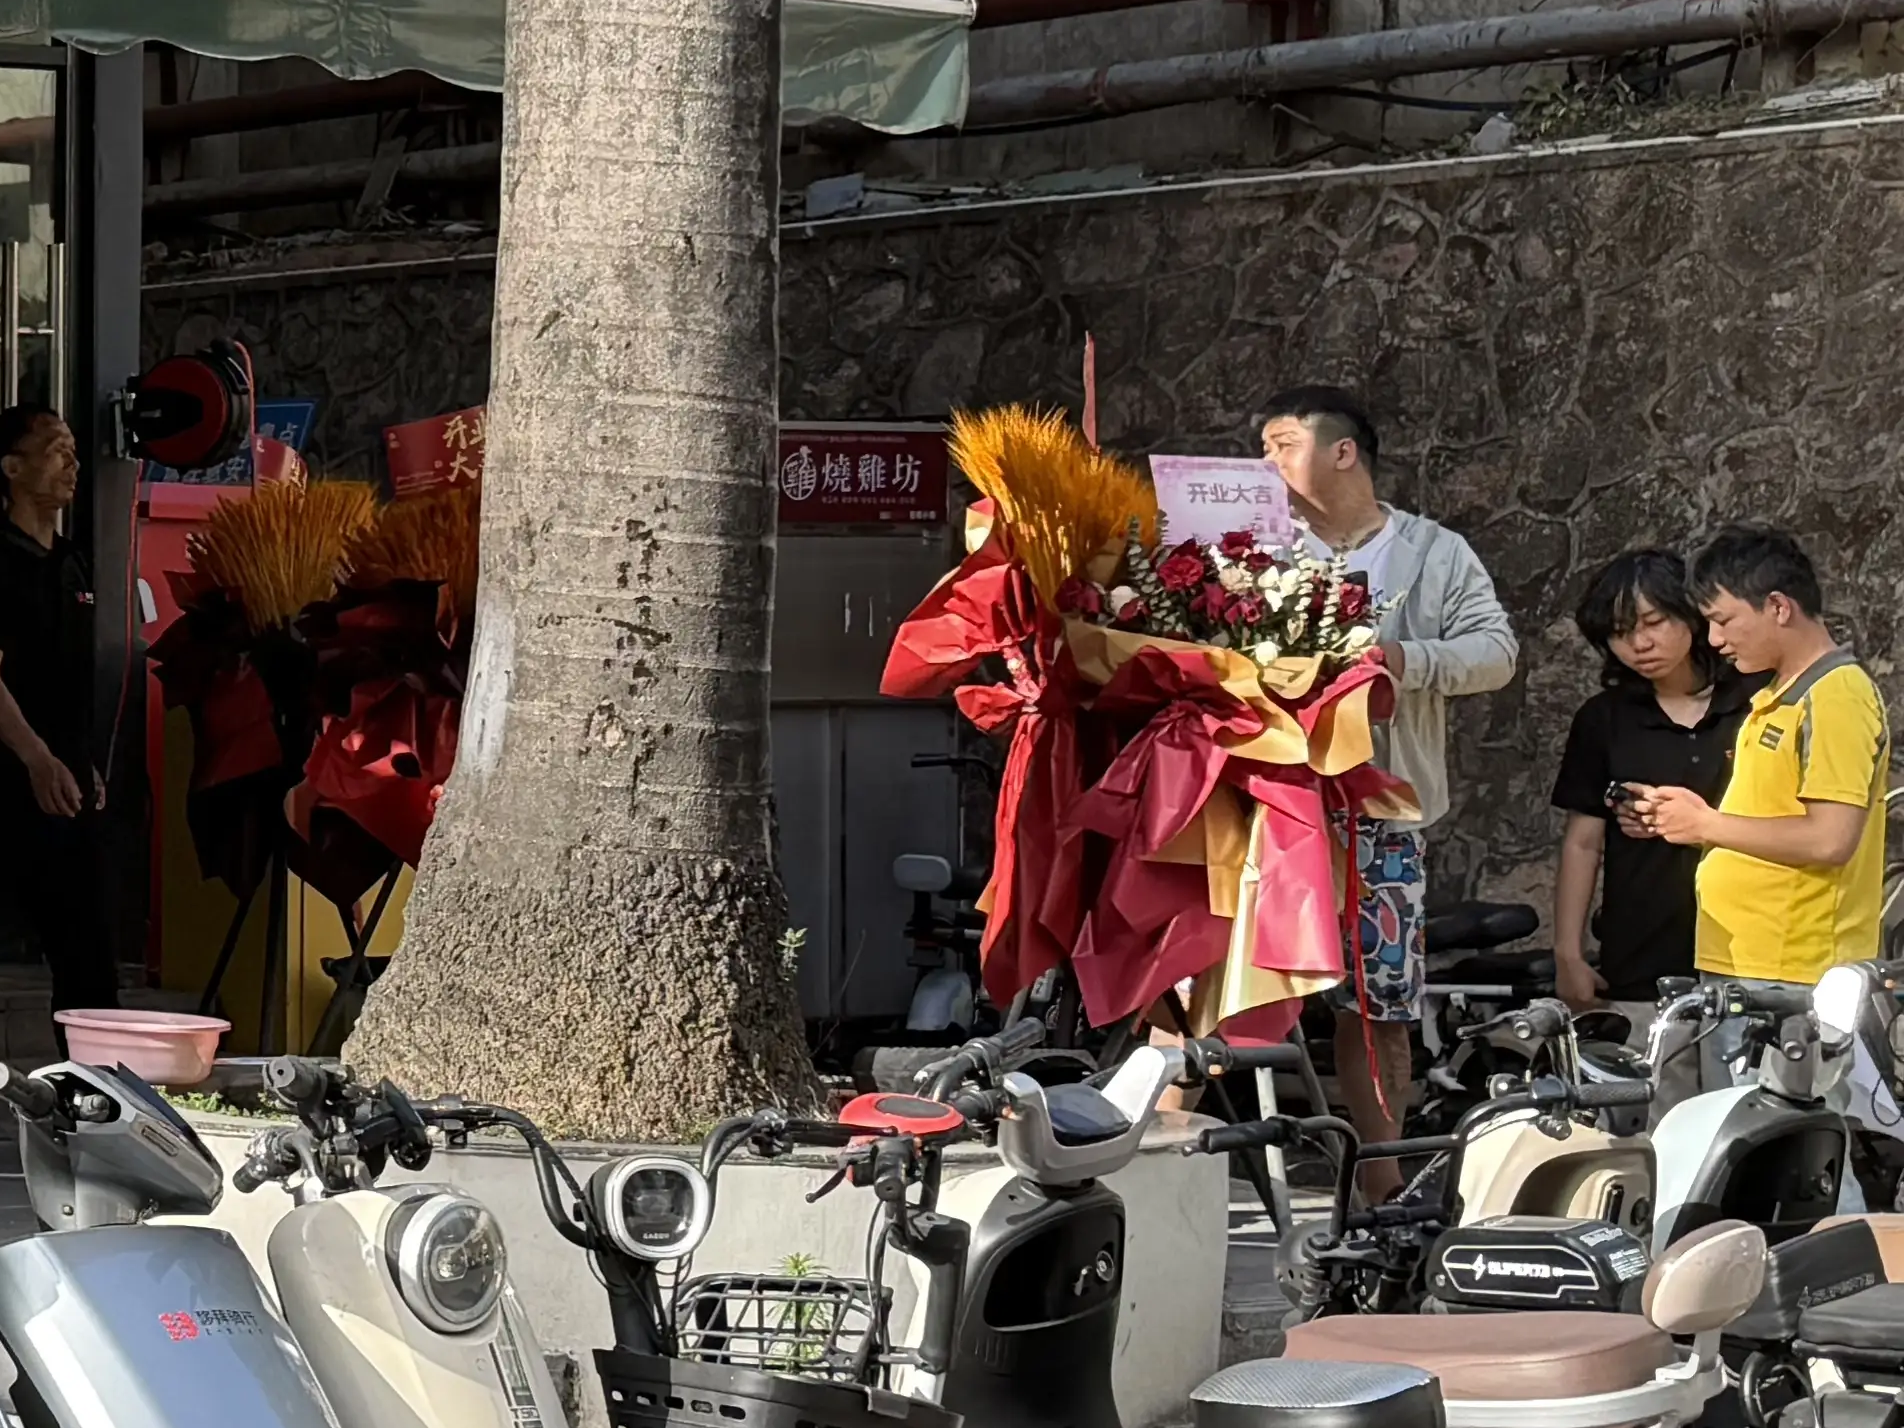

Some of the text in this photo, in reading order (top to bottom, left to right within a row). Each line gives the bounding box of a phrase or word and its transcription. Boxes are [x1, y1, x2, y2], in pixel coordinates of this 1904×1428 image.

[821, 452, 923, 493] 燒雞坊
[1187, 482, 1273, 504] 开业大吉
